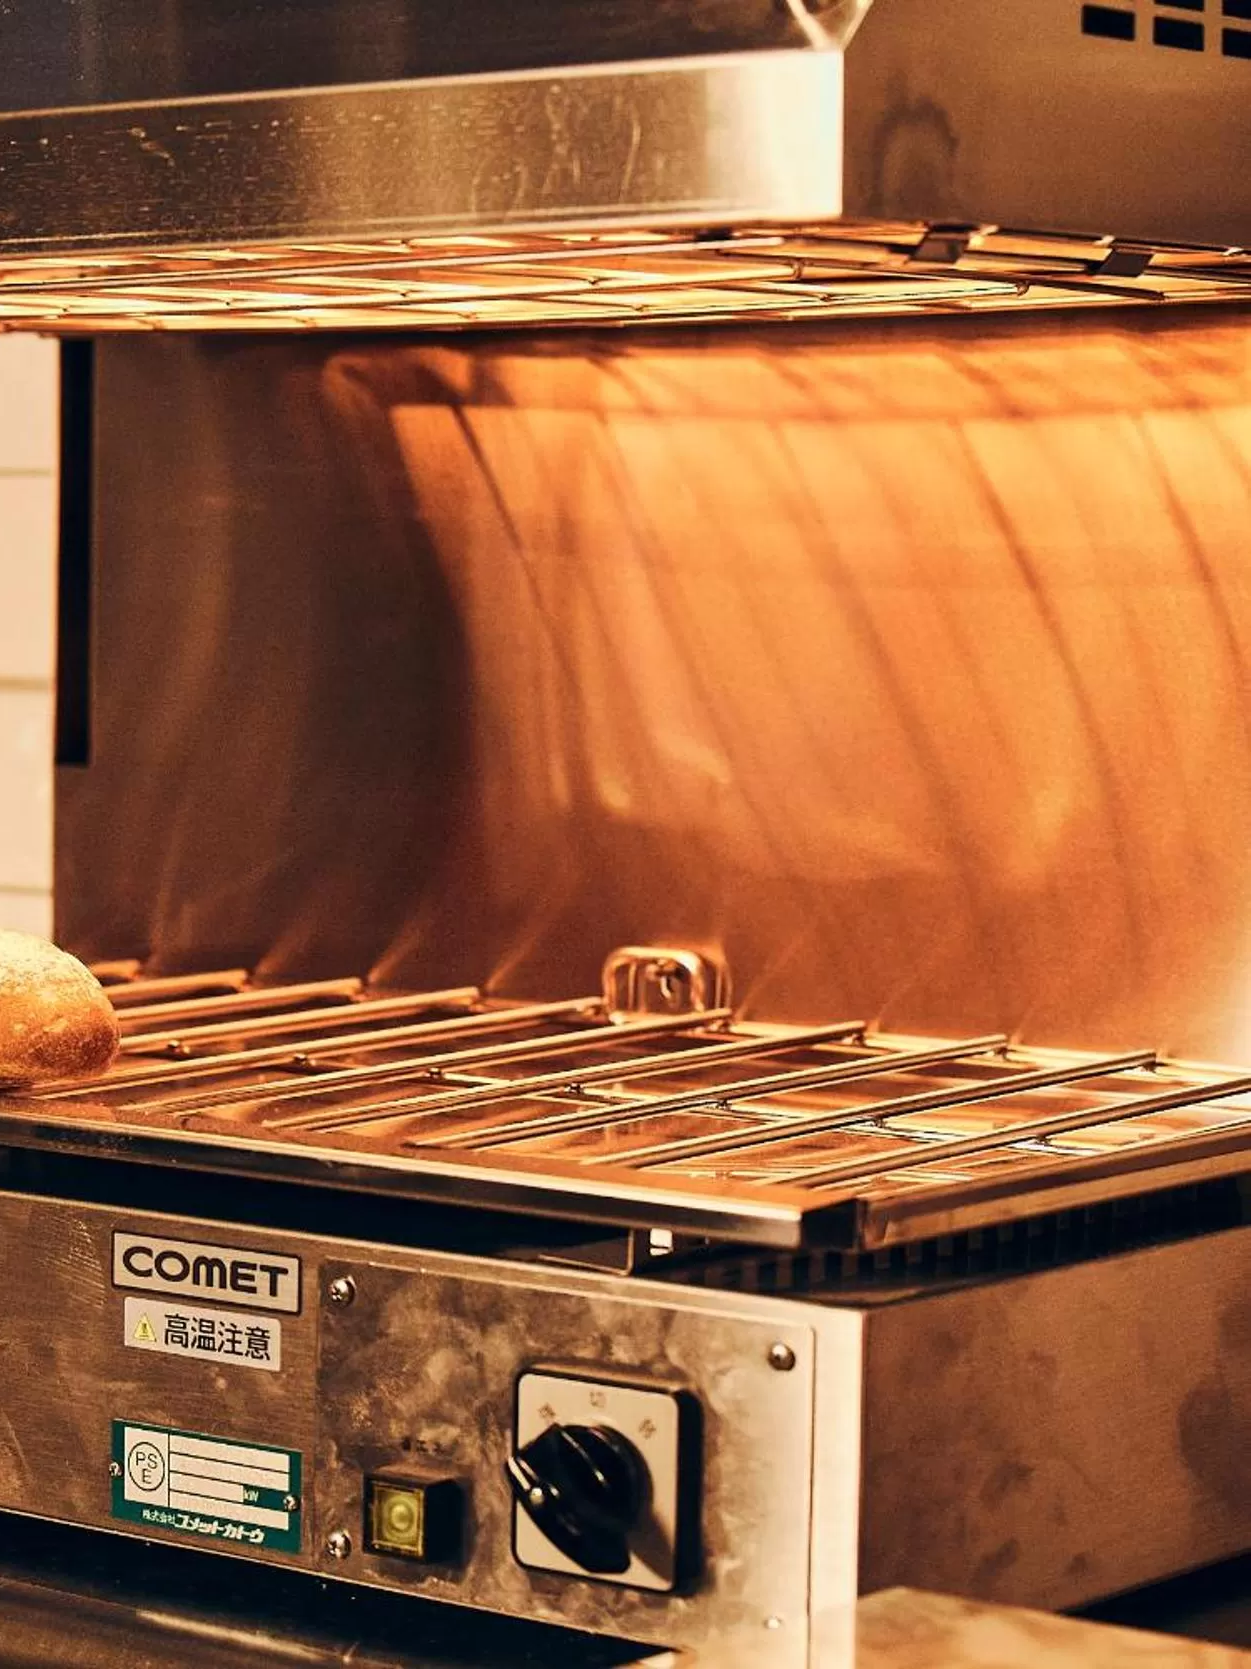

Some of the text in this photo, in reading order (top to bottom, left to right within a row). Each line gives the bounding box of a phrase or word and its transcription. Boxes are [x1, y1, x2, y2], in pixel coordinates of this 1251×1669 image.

[122, 1246, 289, 1297] COMET
[164, 1313, 271, 1361] 高温注意
